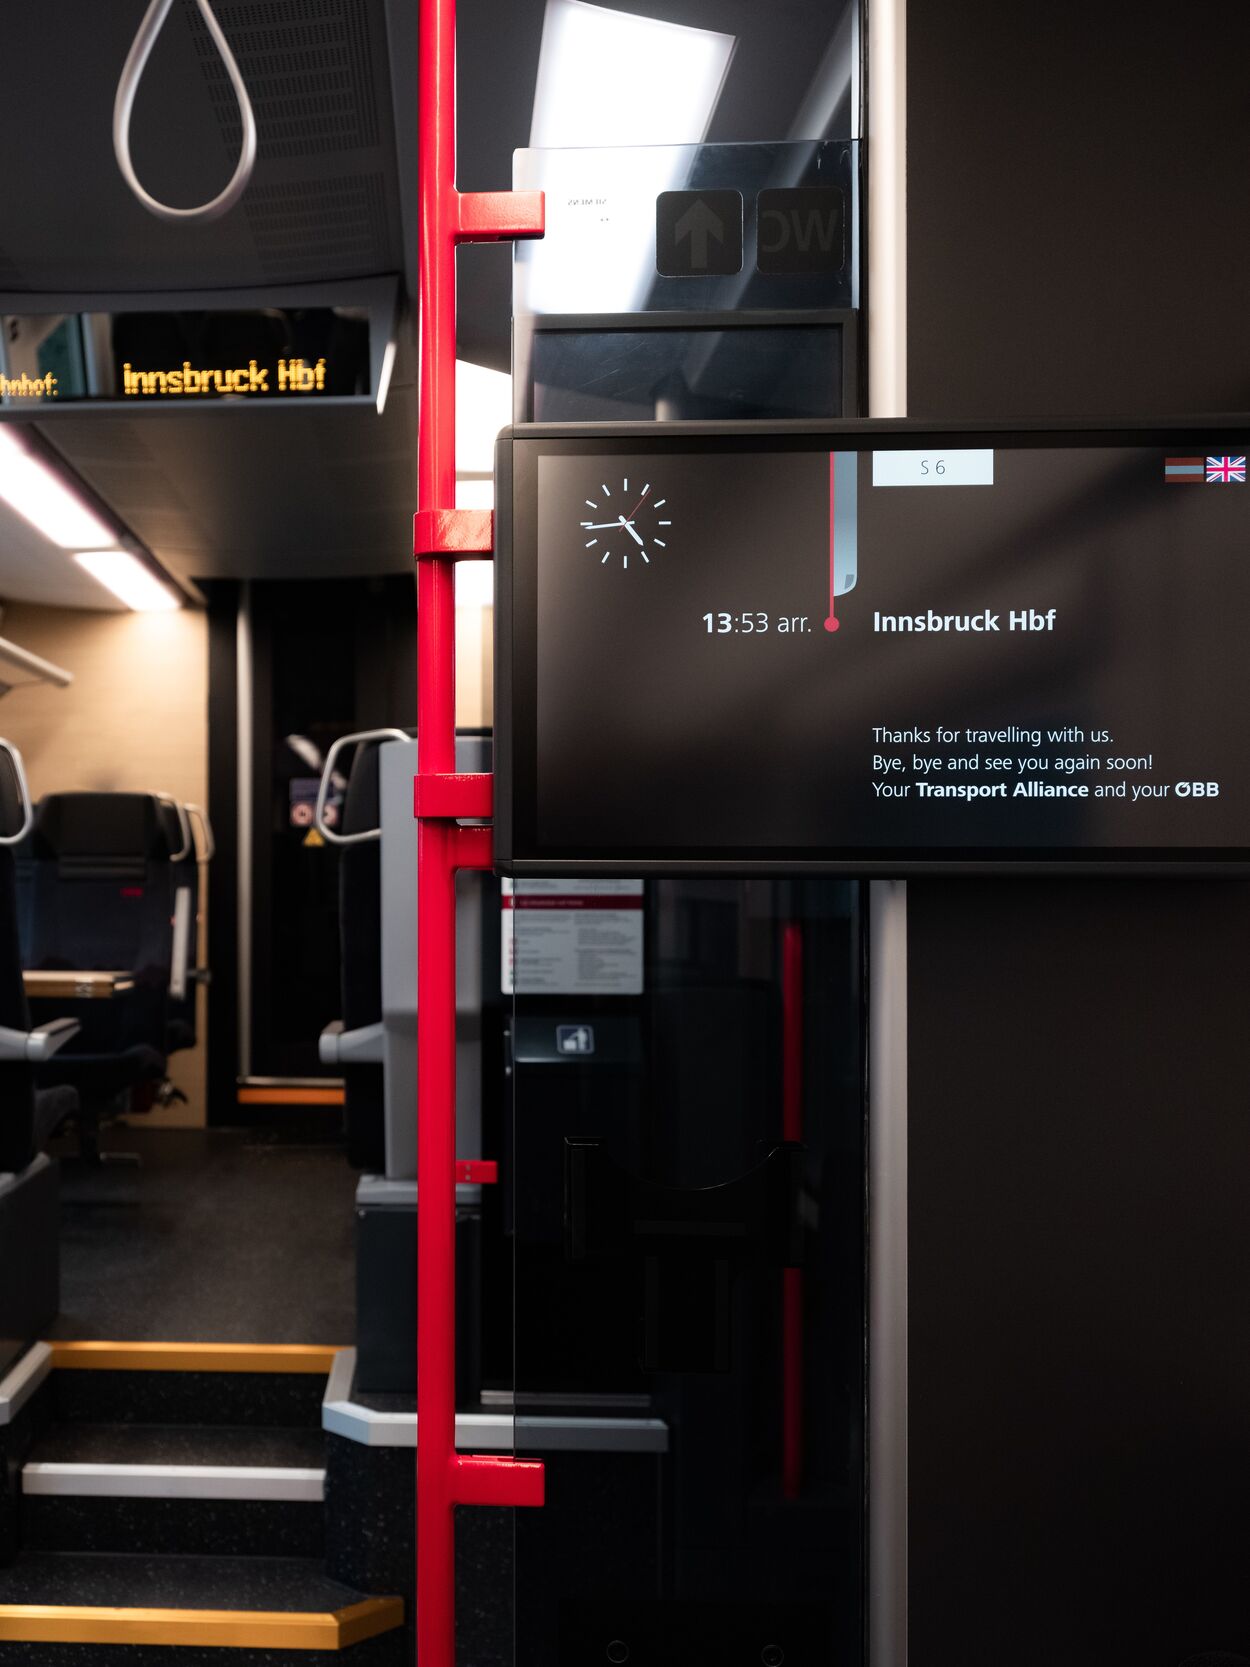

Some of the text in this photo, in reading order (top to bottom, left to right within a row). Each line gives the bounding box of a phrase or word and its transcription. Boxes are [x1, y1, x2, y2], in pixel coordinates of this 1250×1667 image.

[0, 358, 326, 397] hnhof: Innsbruck Hbf
[920, 459, 946, 476] S 6
[702, 612, 812, 634] 13:53 arr.
[873, 608, 1057, 632] Innsbruck Hbf
[872, 726, 1114, 747] Thanks for travelling with us.
[872, 753, 1153, 775] Bye, bye and see you again soon!
[872, 781, 911, 798] Your
[915, 782, 1008, 802] Transport
[1012, 781, 1089, 798] Alliance
[1094, 780, 1126, 798] and
[1131, 785, 1171, 802] your
